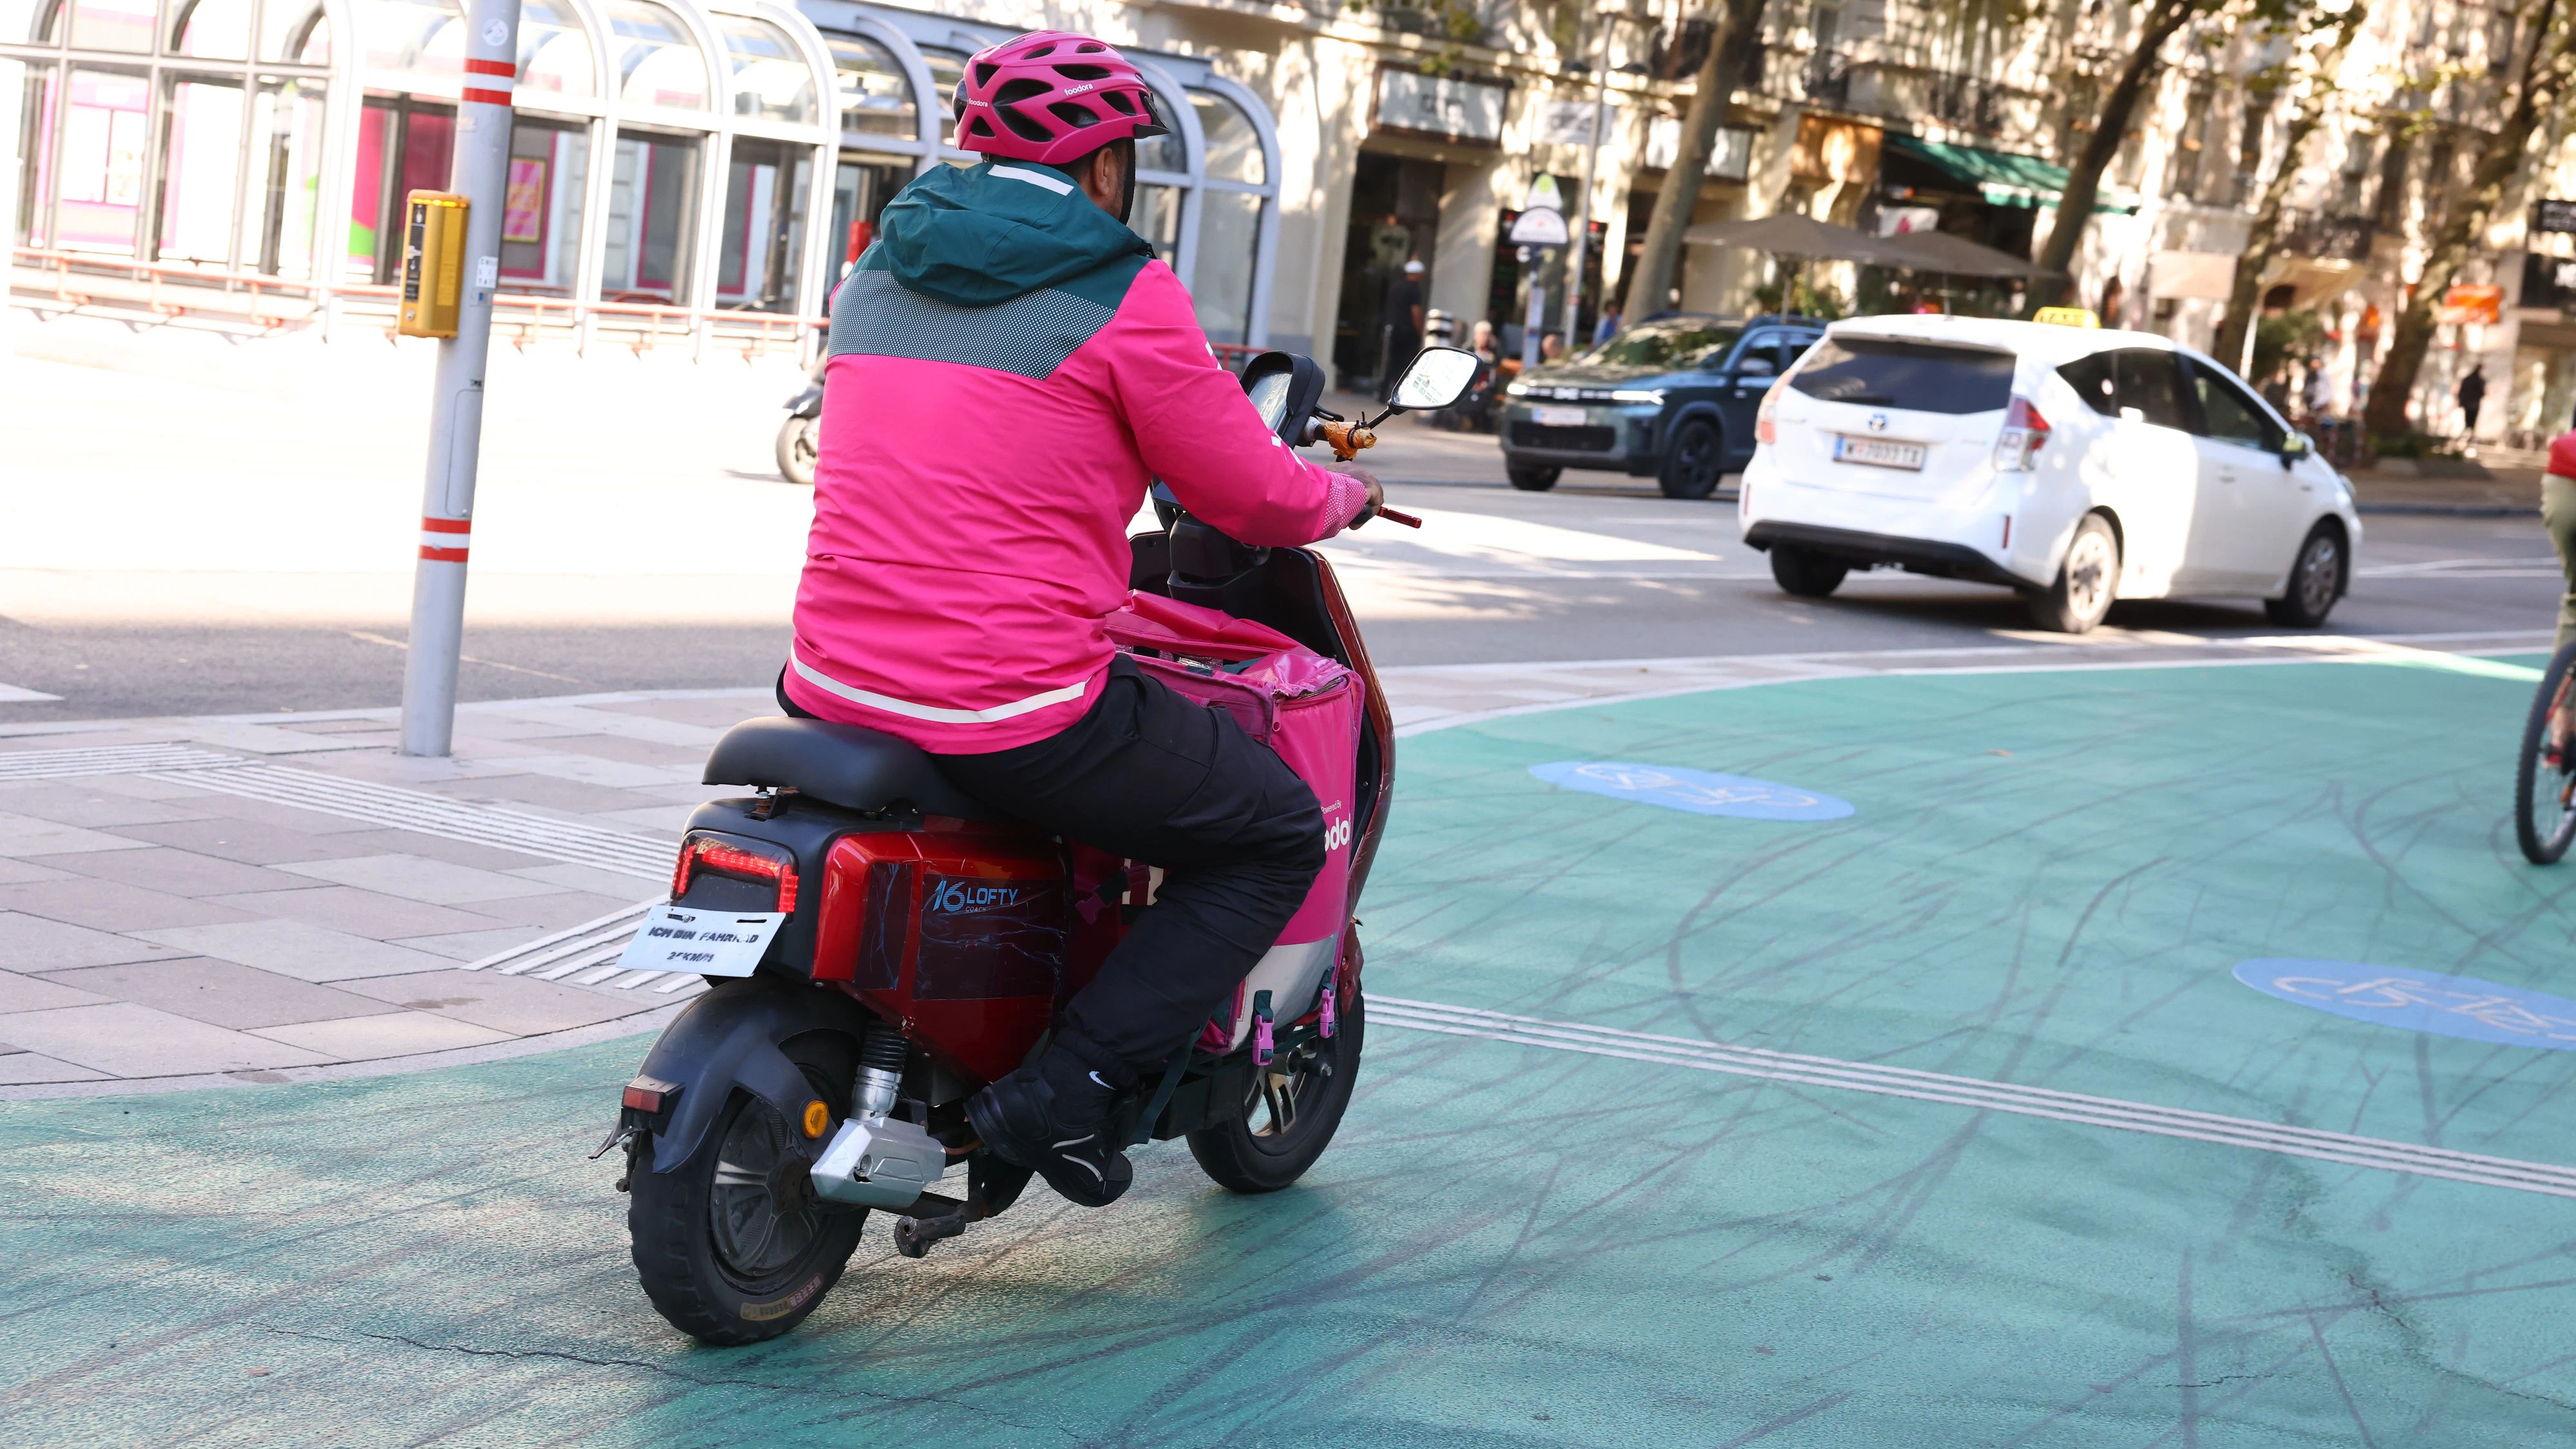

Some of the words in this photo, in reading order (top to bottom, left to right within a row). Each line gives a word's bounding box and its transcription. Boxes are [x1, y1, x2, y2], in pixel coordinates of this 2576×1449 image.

[1064, 83, 1094, 96] foodora
[969, 98, 989, 108] foodora
[1321, 801, 1336, 814] Powered
[1336, 799, 1342, 810] By
[933, 880, 965, 912] 16
[967, 887, 1019, 905] LOFTY
[648, 927, 674, 938] ICH
[672, 929, 697, 940] BIN
